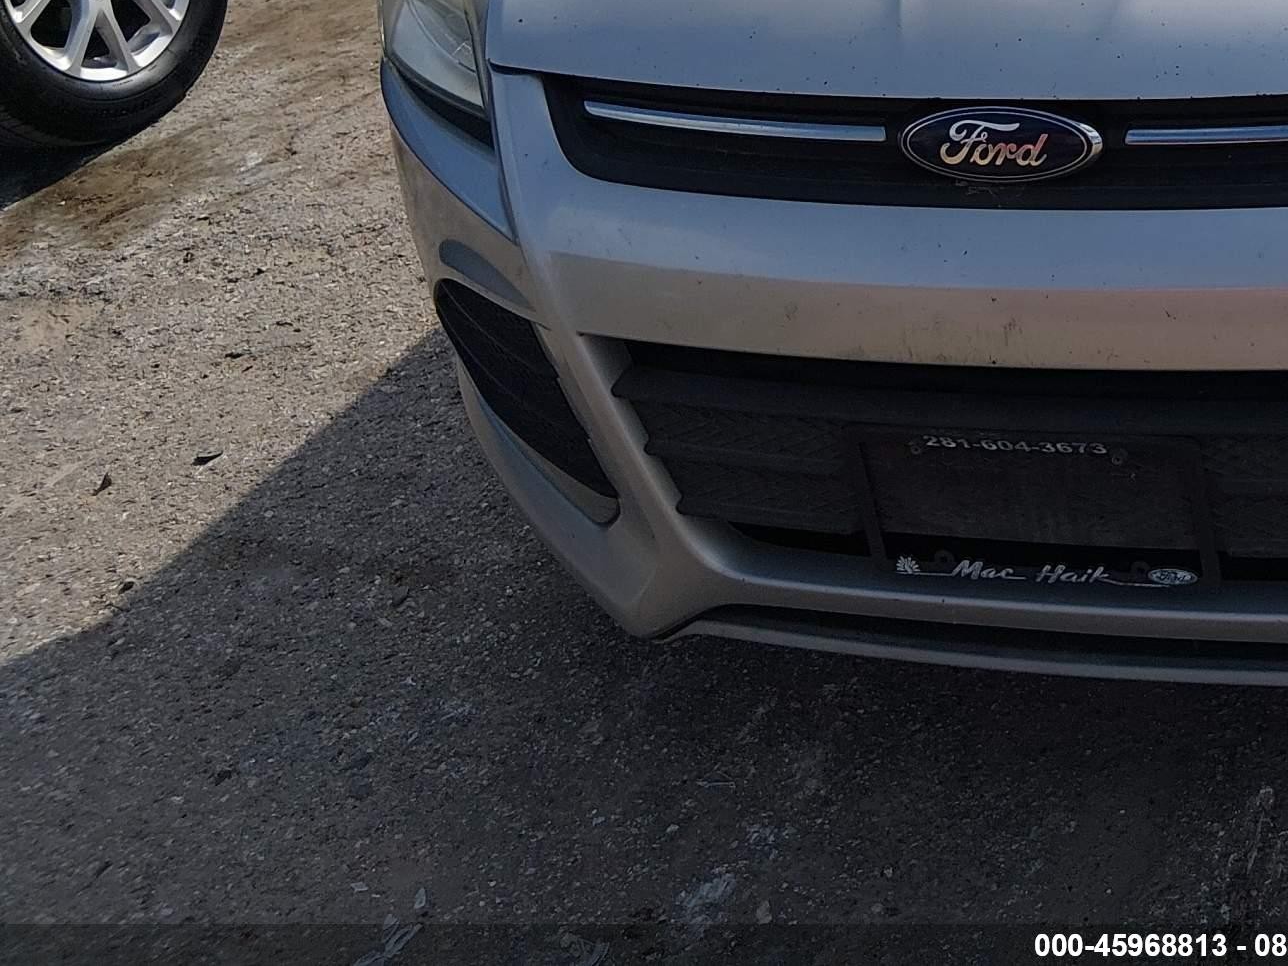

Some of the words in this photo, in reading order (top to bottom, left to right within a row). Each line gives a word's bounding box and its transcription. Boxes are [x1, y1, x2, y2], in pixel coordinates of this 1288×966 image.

[940, 119, 1049, 167] Ford
[922, 434, 1108, 455] 281-604-3673
[951, 559, 1026, 581] Mac
[1035, 564, 1110, 584] Haik
